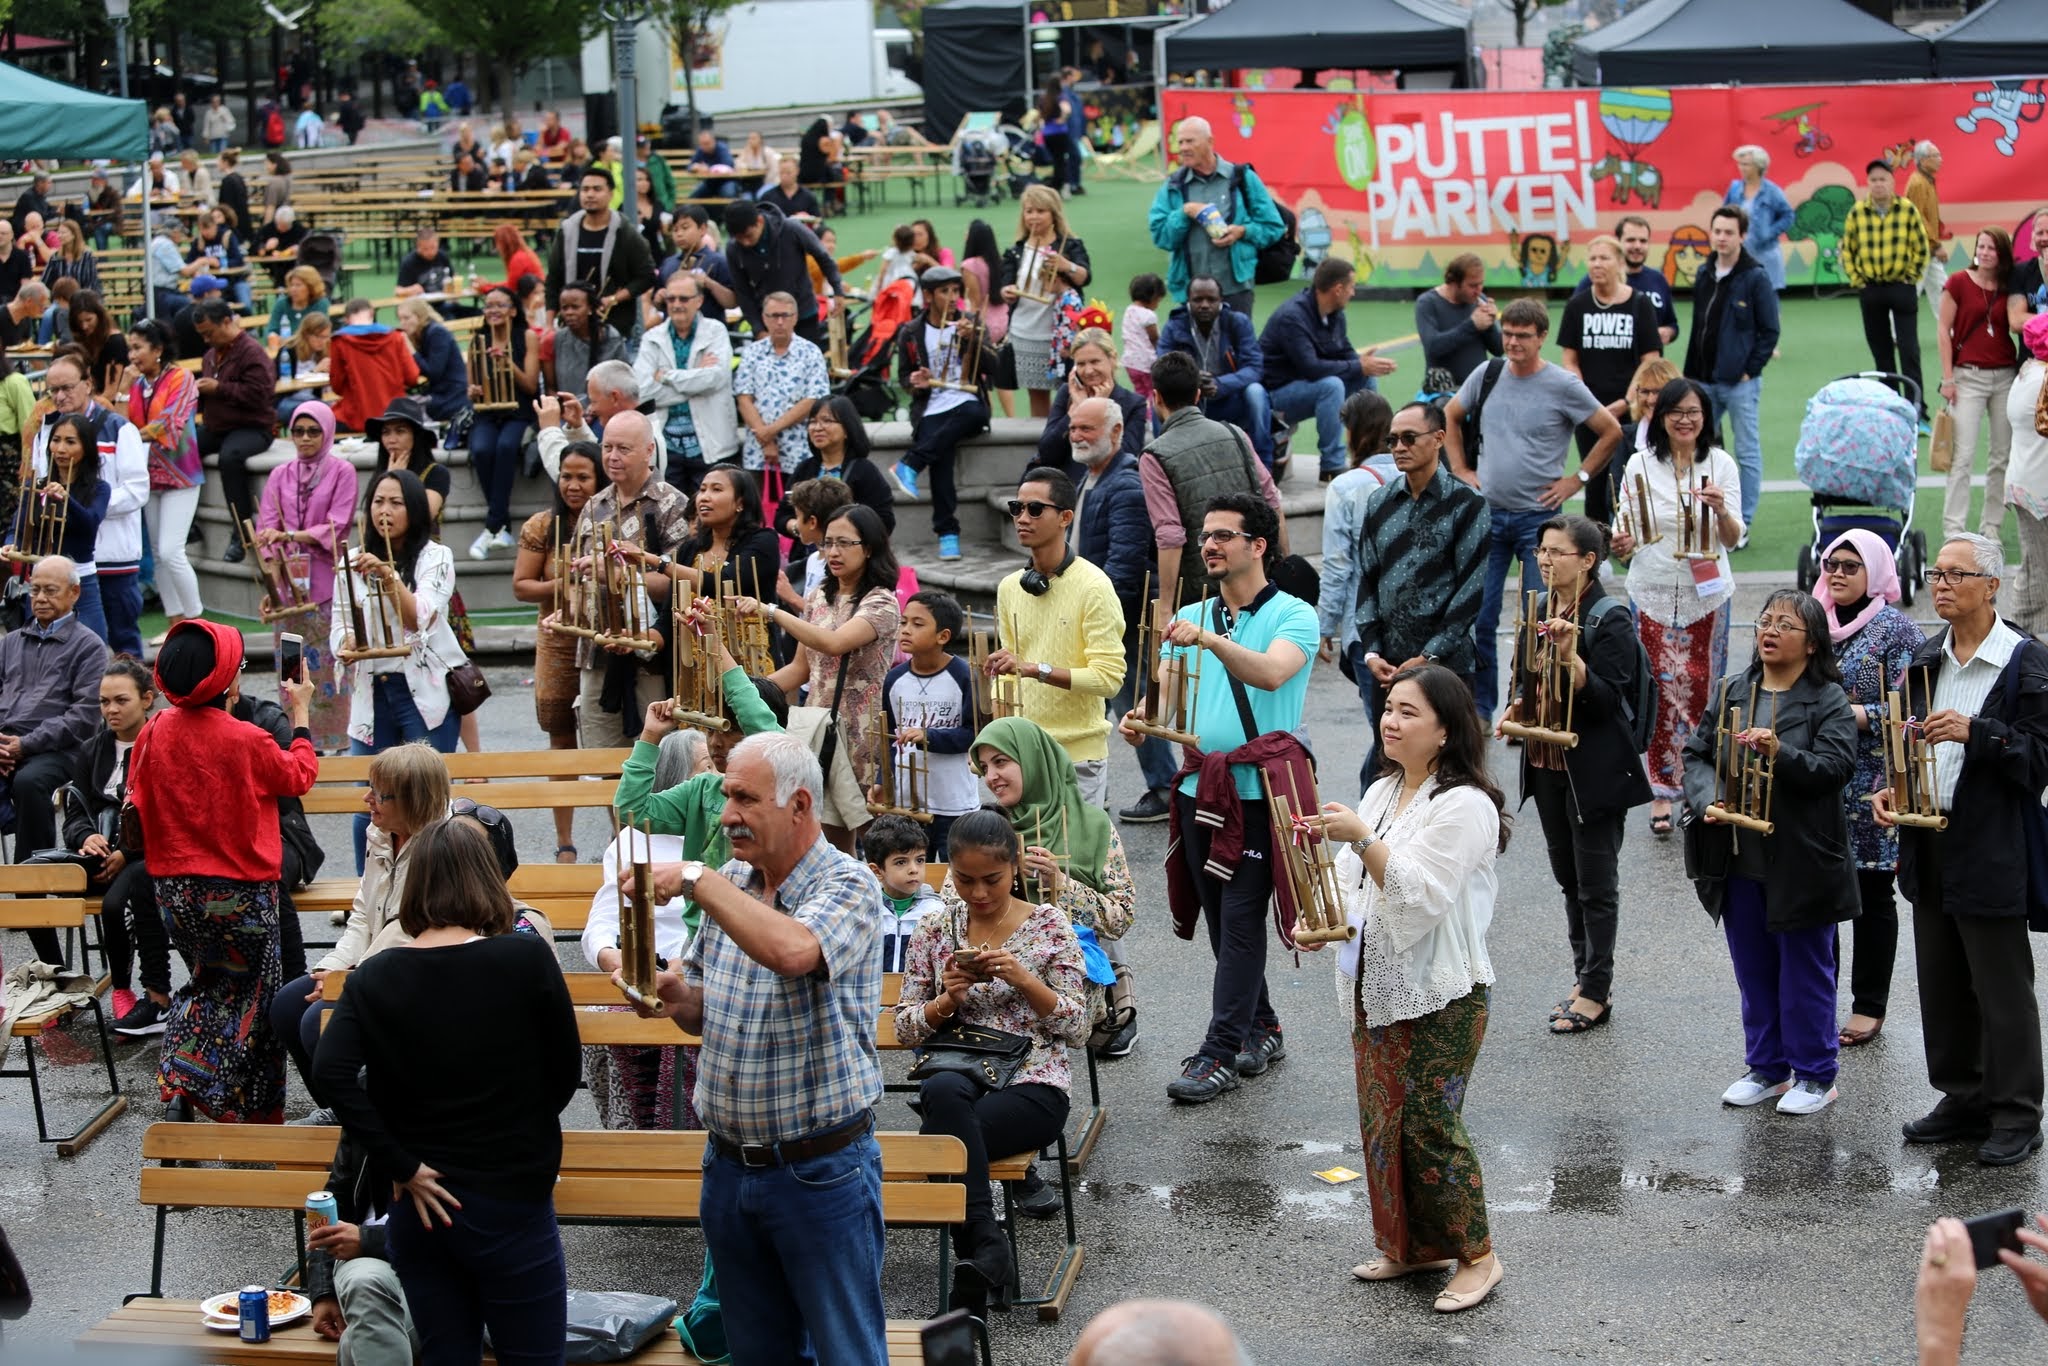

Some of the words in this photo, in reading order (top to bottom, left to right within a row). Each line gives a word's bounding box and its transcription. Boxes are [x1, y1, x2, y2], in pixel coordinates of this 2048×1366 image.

[1367, 162, 1597, 250] PARKEN
[1583, 313, 1634, 335] POWER
[1594, 335, 1633, 349] EQUALITY
[939, 707, 952, 716] 27
[1243, 849, 1263, 859] FILA
